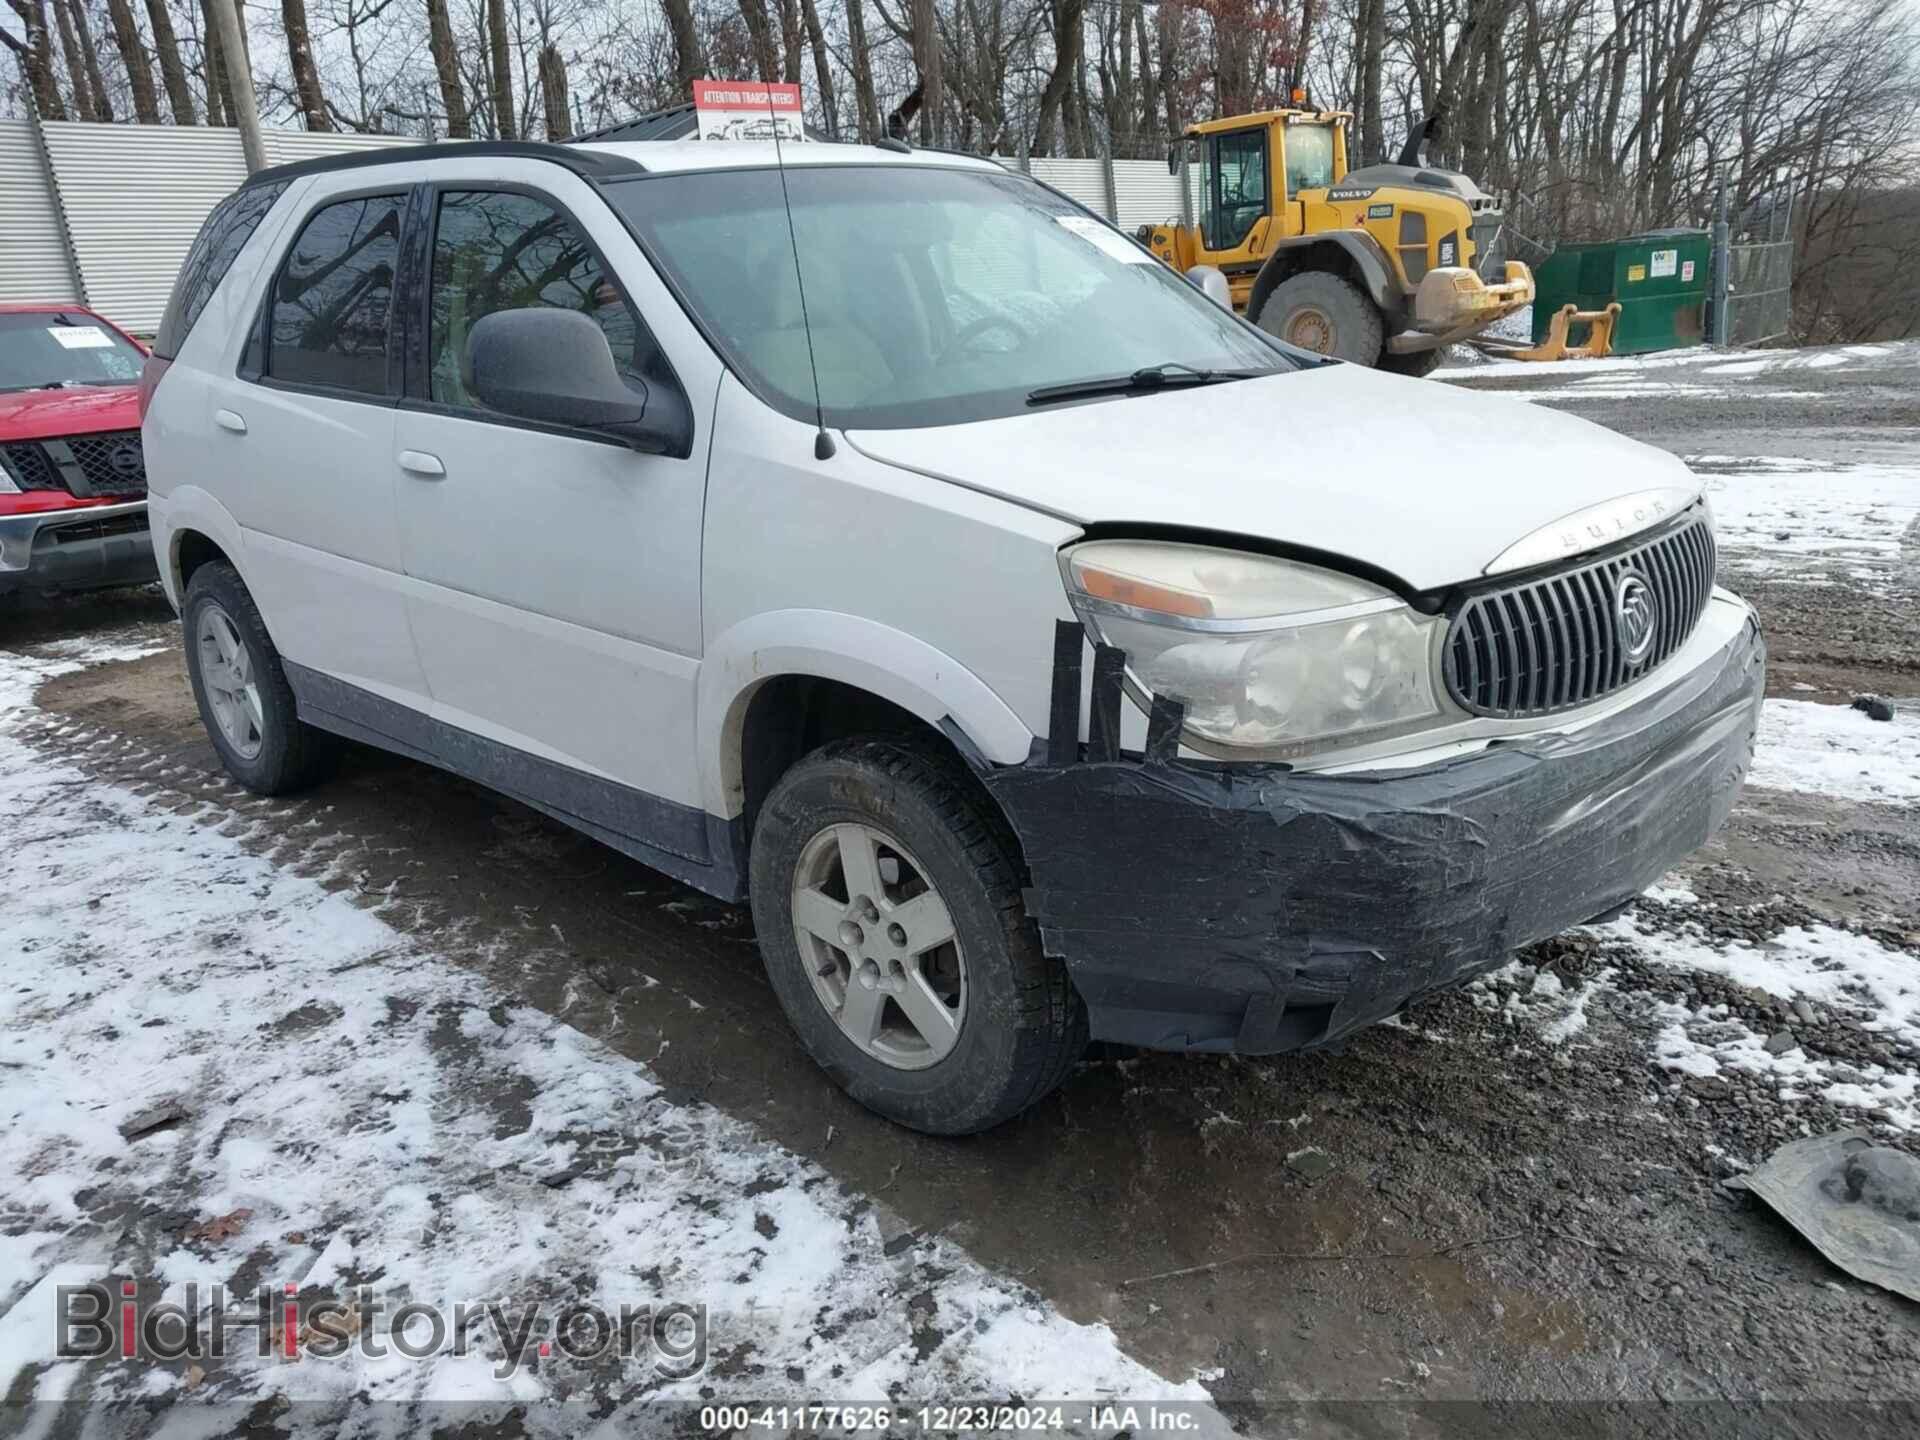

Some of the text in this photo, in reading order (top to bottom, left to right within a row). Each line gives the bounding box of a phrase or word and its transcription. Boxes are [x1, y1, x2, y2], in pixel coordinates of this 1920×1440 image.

[704, 90, 739, 103] ATTENTION
[1332, 190, 1372, 198] VOLVO
[1560, 501, 1665, 548] BUICK
